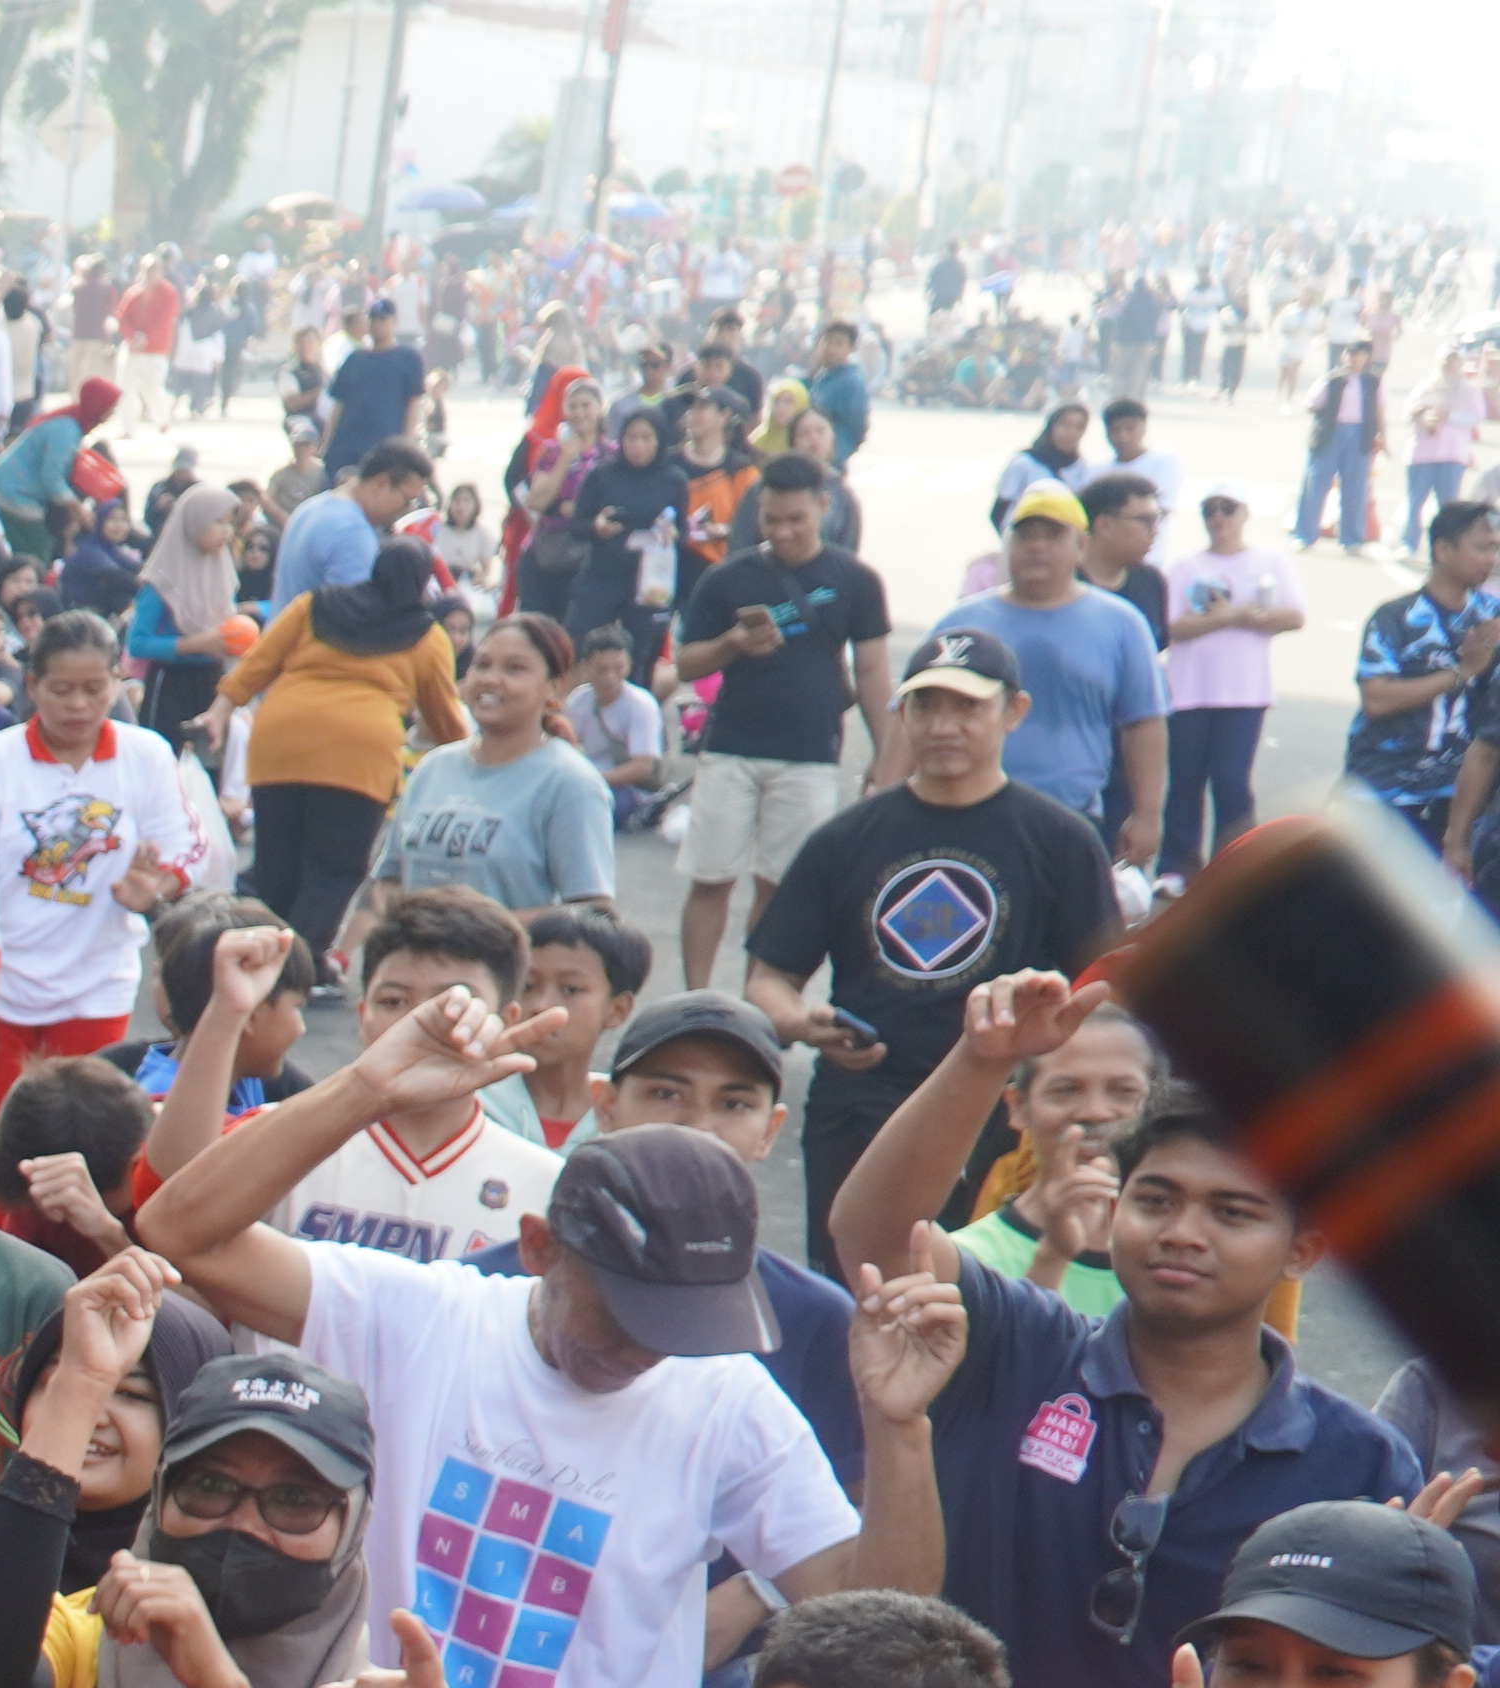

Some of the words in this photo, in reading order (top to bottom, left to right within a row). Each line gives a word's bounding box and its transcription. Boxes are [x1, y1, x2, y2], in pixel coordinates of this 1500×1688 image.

[297, 1202, 454, 1264] SMPN
[1037, 1425, 1080, 1453] HARI
[1044, 1411, 1087, 1439] HARI
[1269, 1552, 1334, 1569] CRUISE
